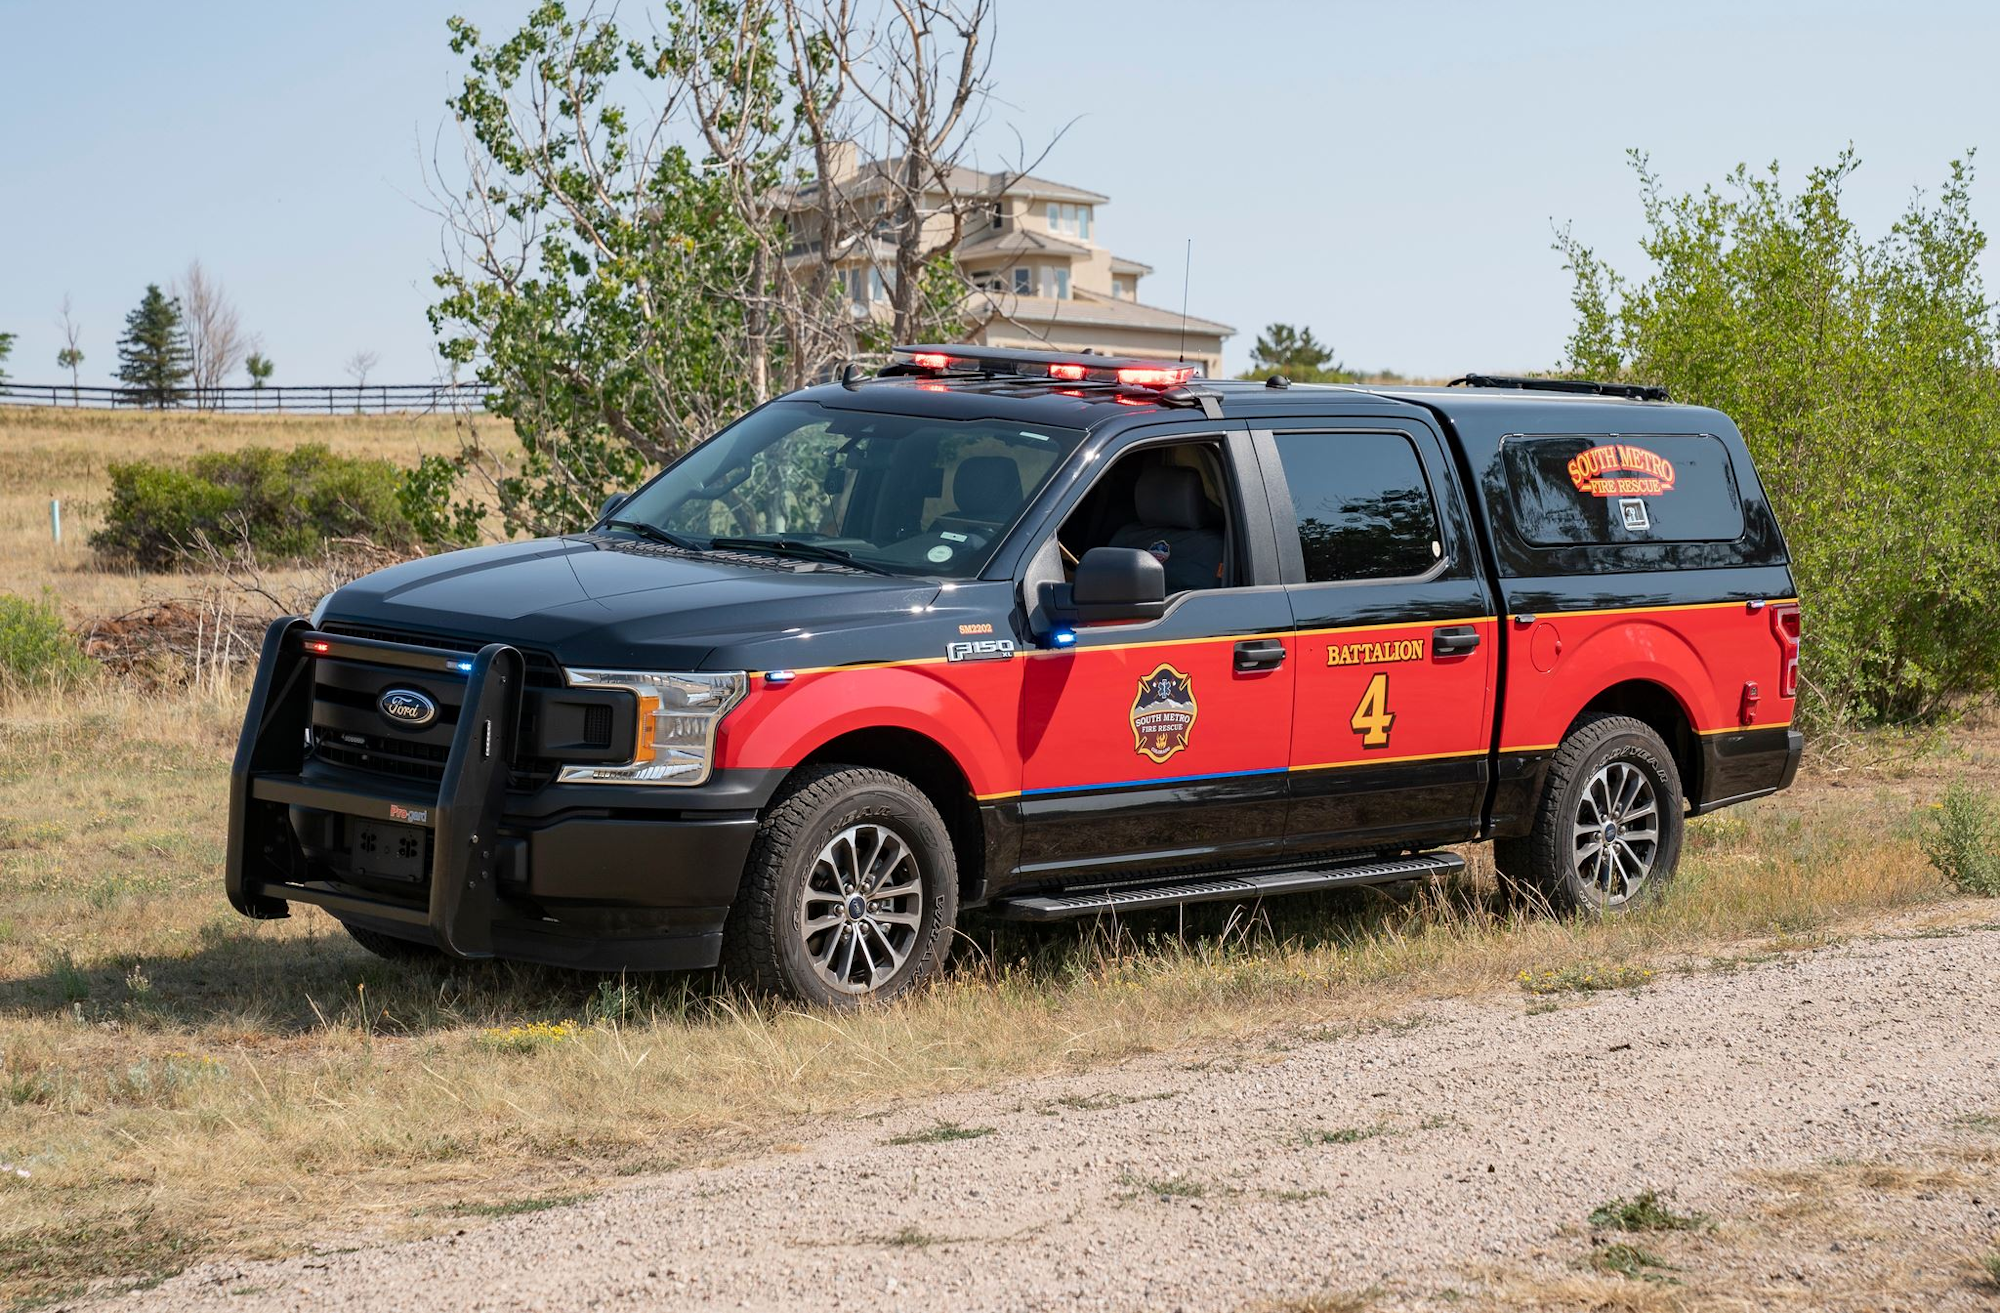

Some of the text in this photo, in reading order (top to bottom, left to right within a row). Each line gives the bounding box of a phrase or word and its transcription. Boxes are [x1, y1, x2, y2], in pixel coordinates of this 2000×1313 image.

[1568, 446, 1673, 483] SOUTH METRO
[1590, 480, 1661, 493] FIRE RESCUE
[958, 623, 993, 635] SM2202
[1327, 640, 1424, 666] BATTALION
[388, 696, 420, 717] Ford
[1350, 672, 1396, 749] 4
[1135, 713, 1190, 727] SOUTH METRO
[1158, 724, 1183, 732] RESCUE
[1581, 745, 1668, 794] GOODYEAR
[793, 805, 892, 931] GOODYEAR
